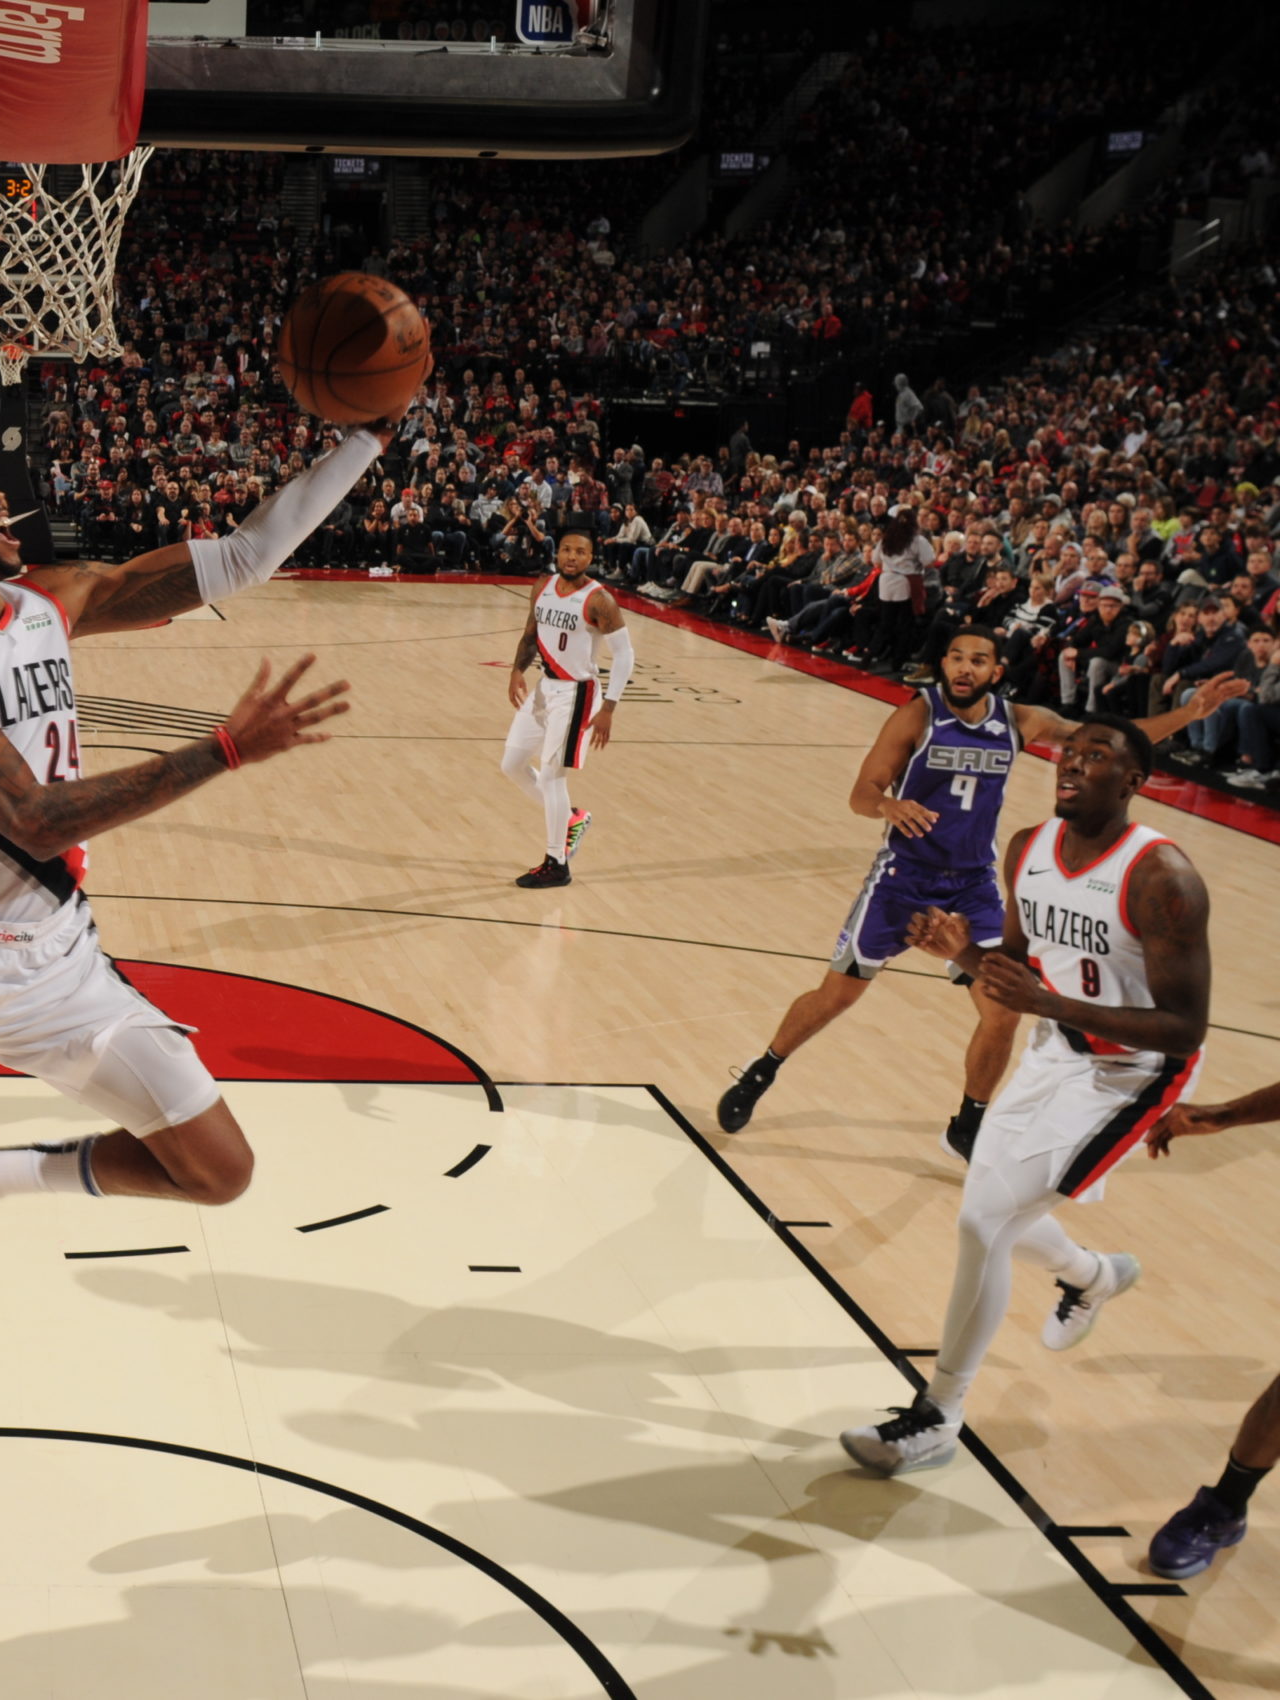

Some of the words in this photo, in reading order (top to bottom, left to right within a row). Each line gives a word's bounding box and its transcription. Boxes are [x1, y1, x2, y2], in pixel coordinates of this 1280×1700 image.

[528, 4, 564, 34] NBA
[559, 632, 568, 652] 0
[45, 719, 79, 784] 24
[926, 745, 1011, 774] SAC
[1080, 957, 1101, 998] 9
